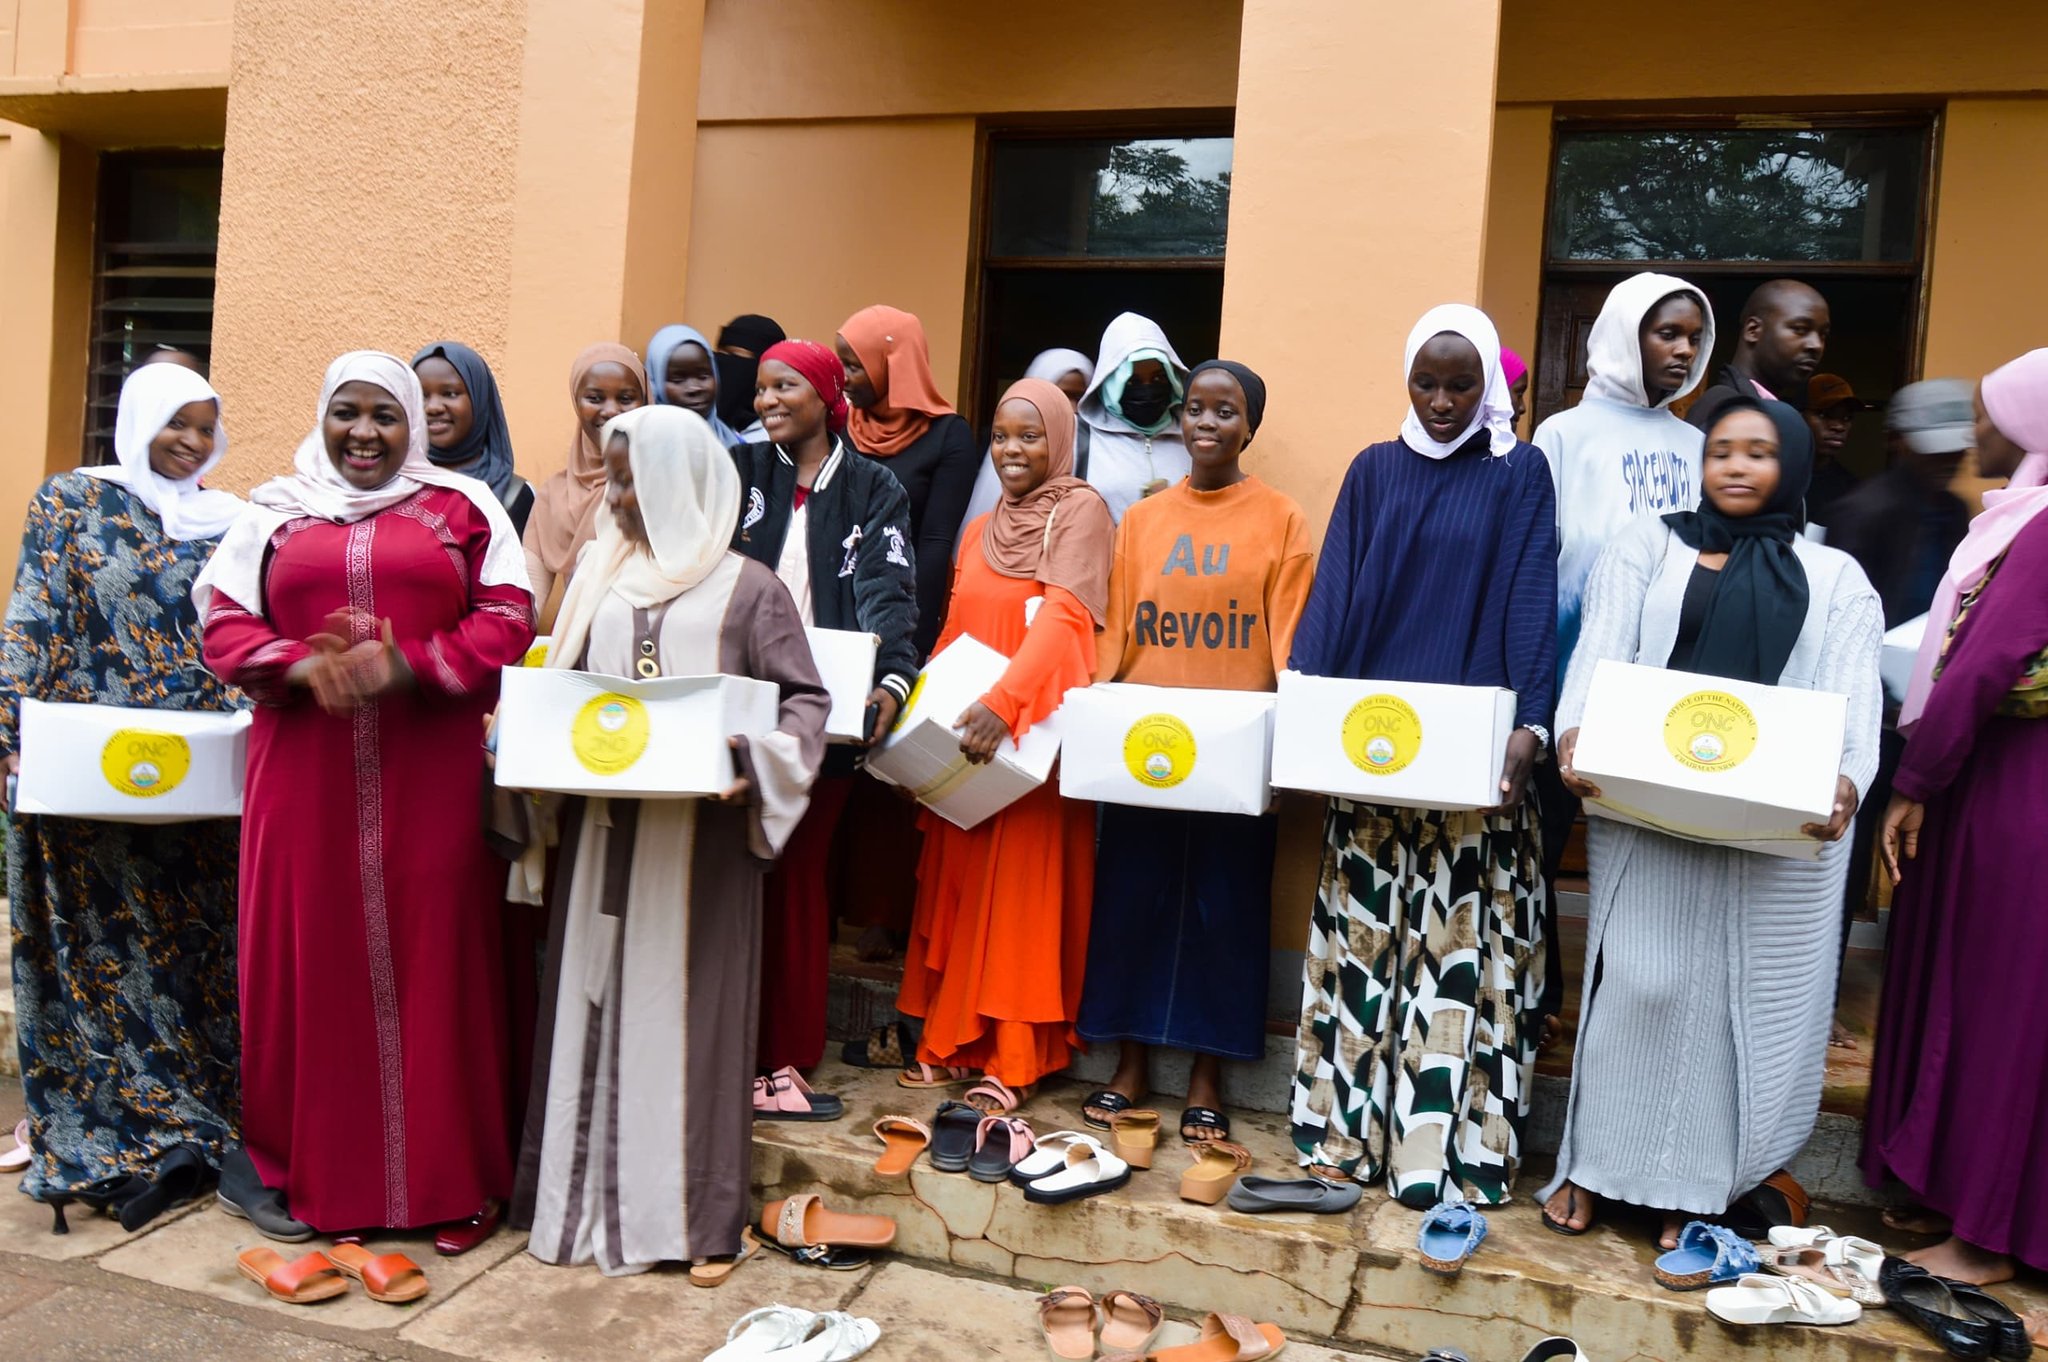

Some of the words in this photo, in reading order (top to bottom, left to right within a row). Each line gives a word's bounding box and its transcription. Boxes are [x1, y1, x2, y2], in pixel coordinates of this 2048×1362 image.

[1161, 534, 1231, 576] Au
[1135, 599, 1257, 649] Revoir
[1667, 698, 1692, 718] OFFICE
[1707, 694, 1723, 702] THE
[1726, 697, 1756, 727] NATIONAL
[1690, 710, 1736, 732] ONC
[1364, 714, 1402, 733] ONC
[127, 740, 169, 760] ONC
[1143, 731, 1177, 750] ONC
[1674, 753, 1716, 772] CHAIRMAN
